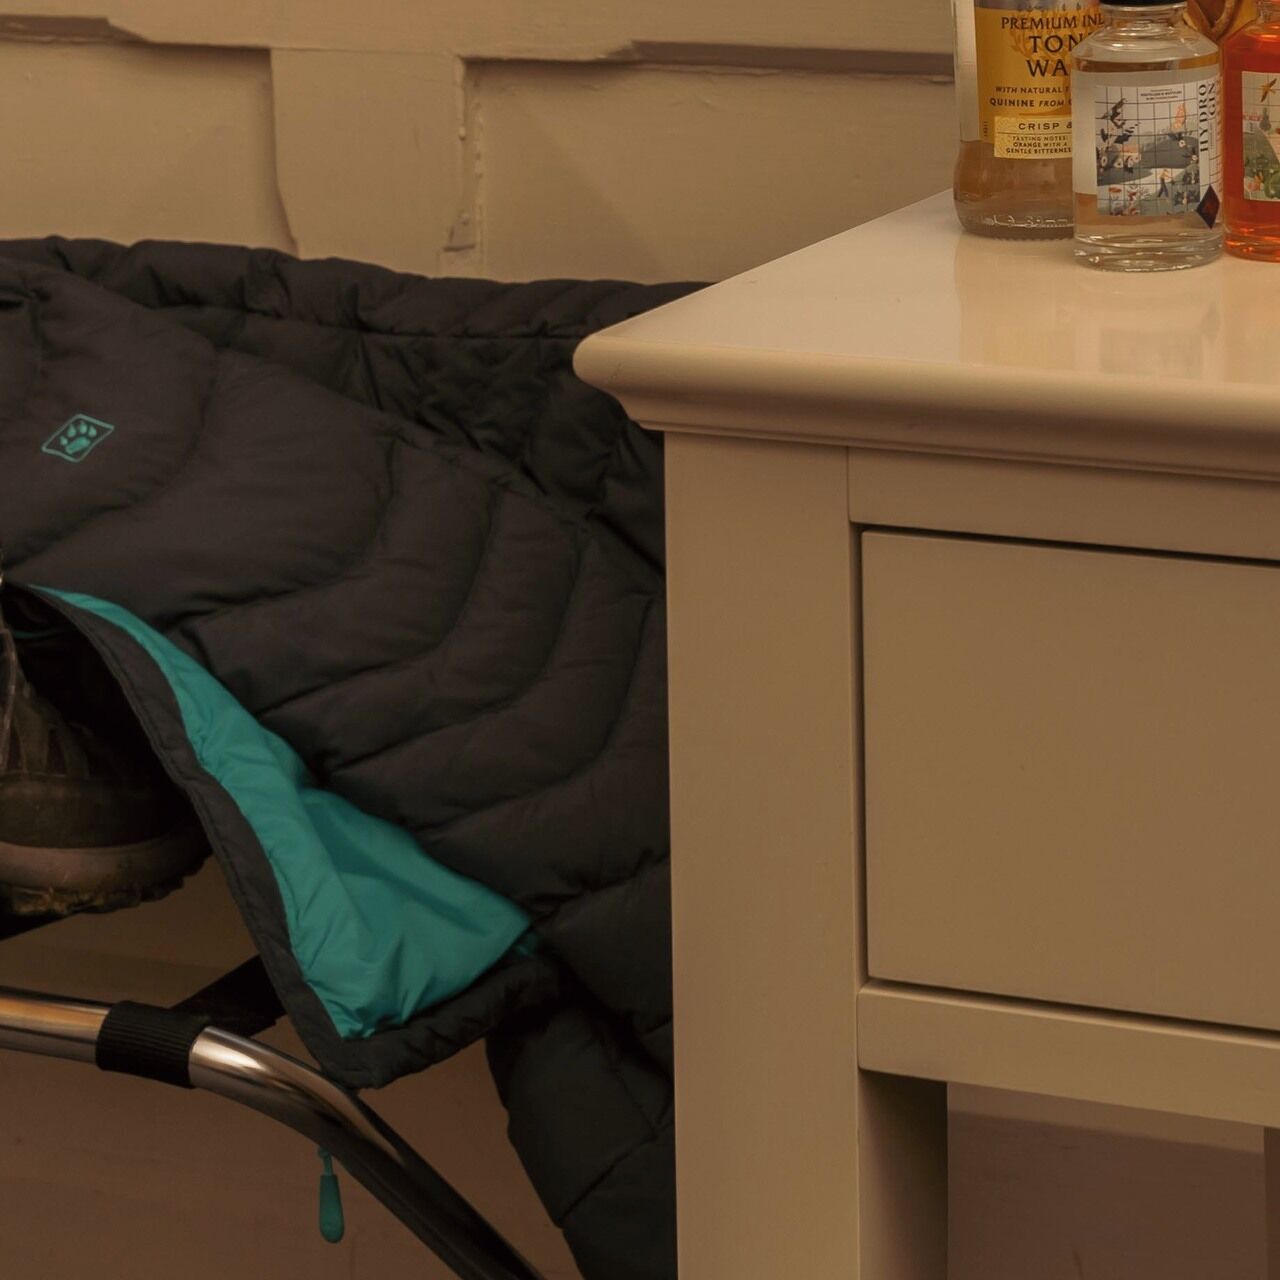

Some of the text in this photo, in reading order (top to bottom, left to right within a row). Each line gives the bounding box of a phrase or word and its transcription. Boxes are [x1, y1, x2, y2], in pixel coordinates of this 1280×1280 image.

[1001, 15, 1077, 31] PREMIUM
[996, 86, 1017, 94] WITH
[1020, 86, 1063, 94] NATURAL
[989, 98, 1035, 107] QUININE
[1039, 99, 1064, 107] FROM
[1198, 83, 1209, 153] HYDRO
[1018, 122, 1060, 130] CRISP
